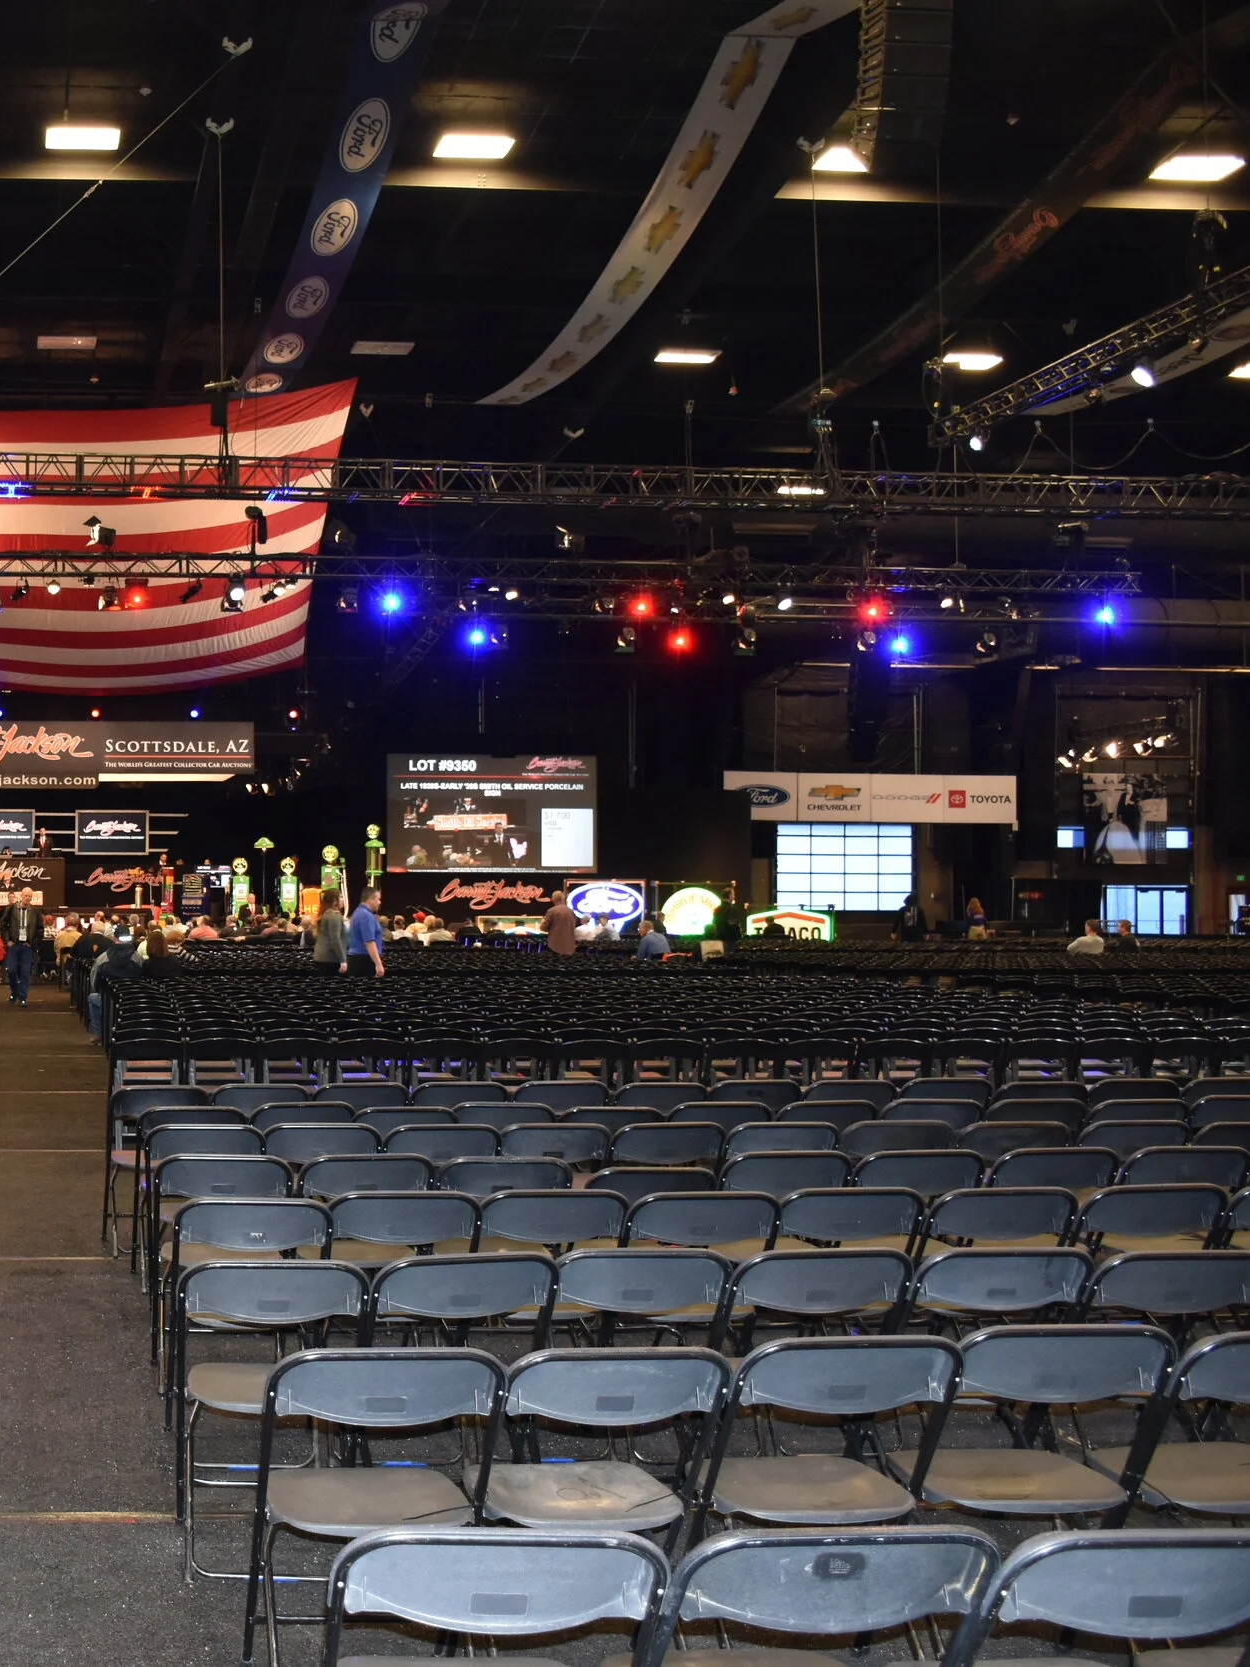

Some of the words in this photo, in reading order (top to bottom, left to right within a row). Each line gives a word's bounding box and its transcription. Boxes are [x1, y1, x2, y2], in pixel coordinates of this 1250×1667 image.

[347, 114, 383, 158] Ford
[317, 211, 352, 247] Ford
[292, 284, 323, 311] Ford
[105, 739, 220, 754] SCOTTSDALE,
[226, 740, 250, 753] AZ
[409, 760, 436, 771] LOT
[438, 760, 477, 772] #9350
[746, 786, 779, 805] Ford
[970, 795, 1012, 804] TOYOTA
[807, 803, 862, 811] CHEVROLET
[435, 878, 551, 910] Barrett-Jackson
[576, 888, 636, 914] Ford
[754, 927, 821, 940] TACO
